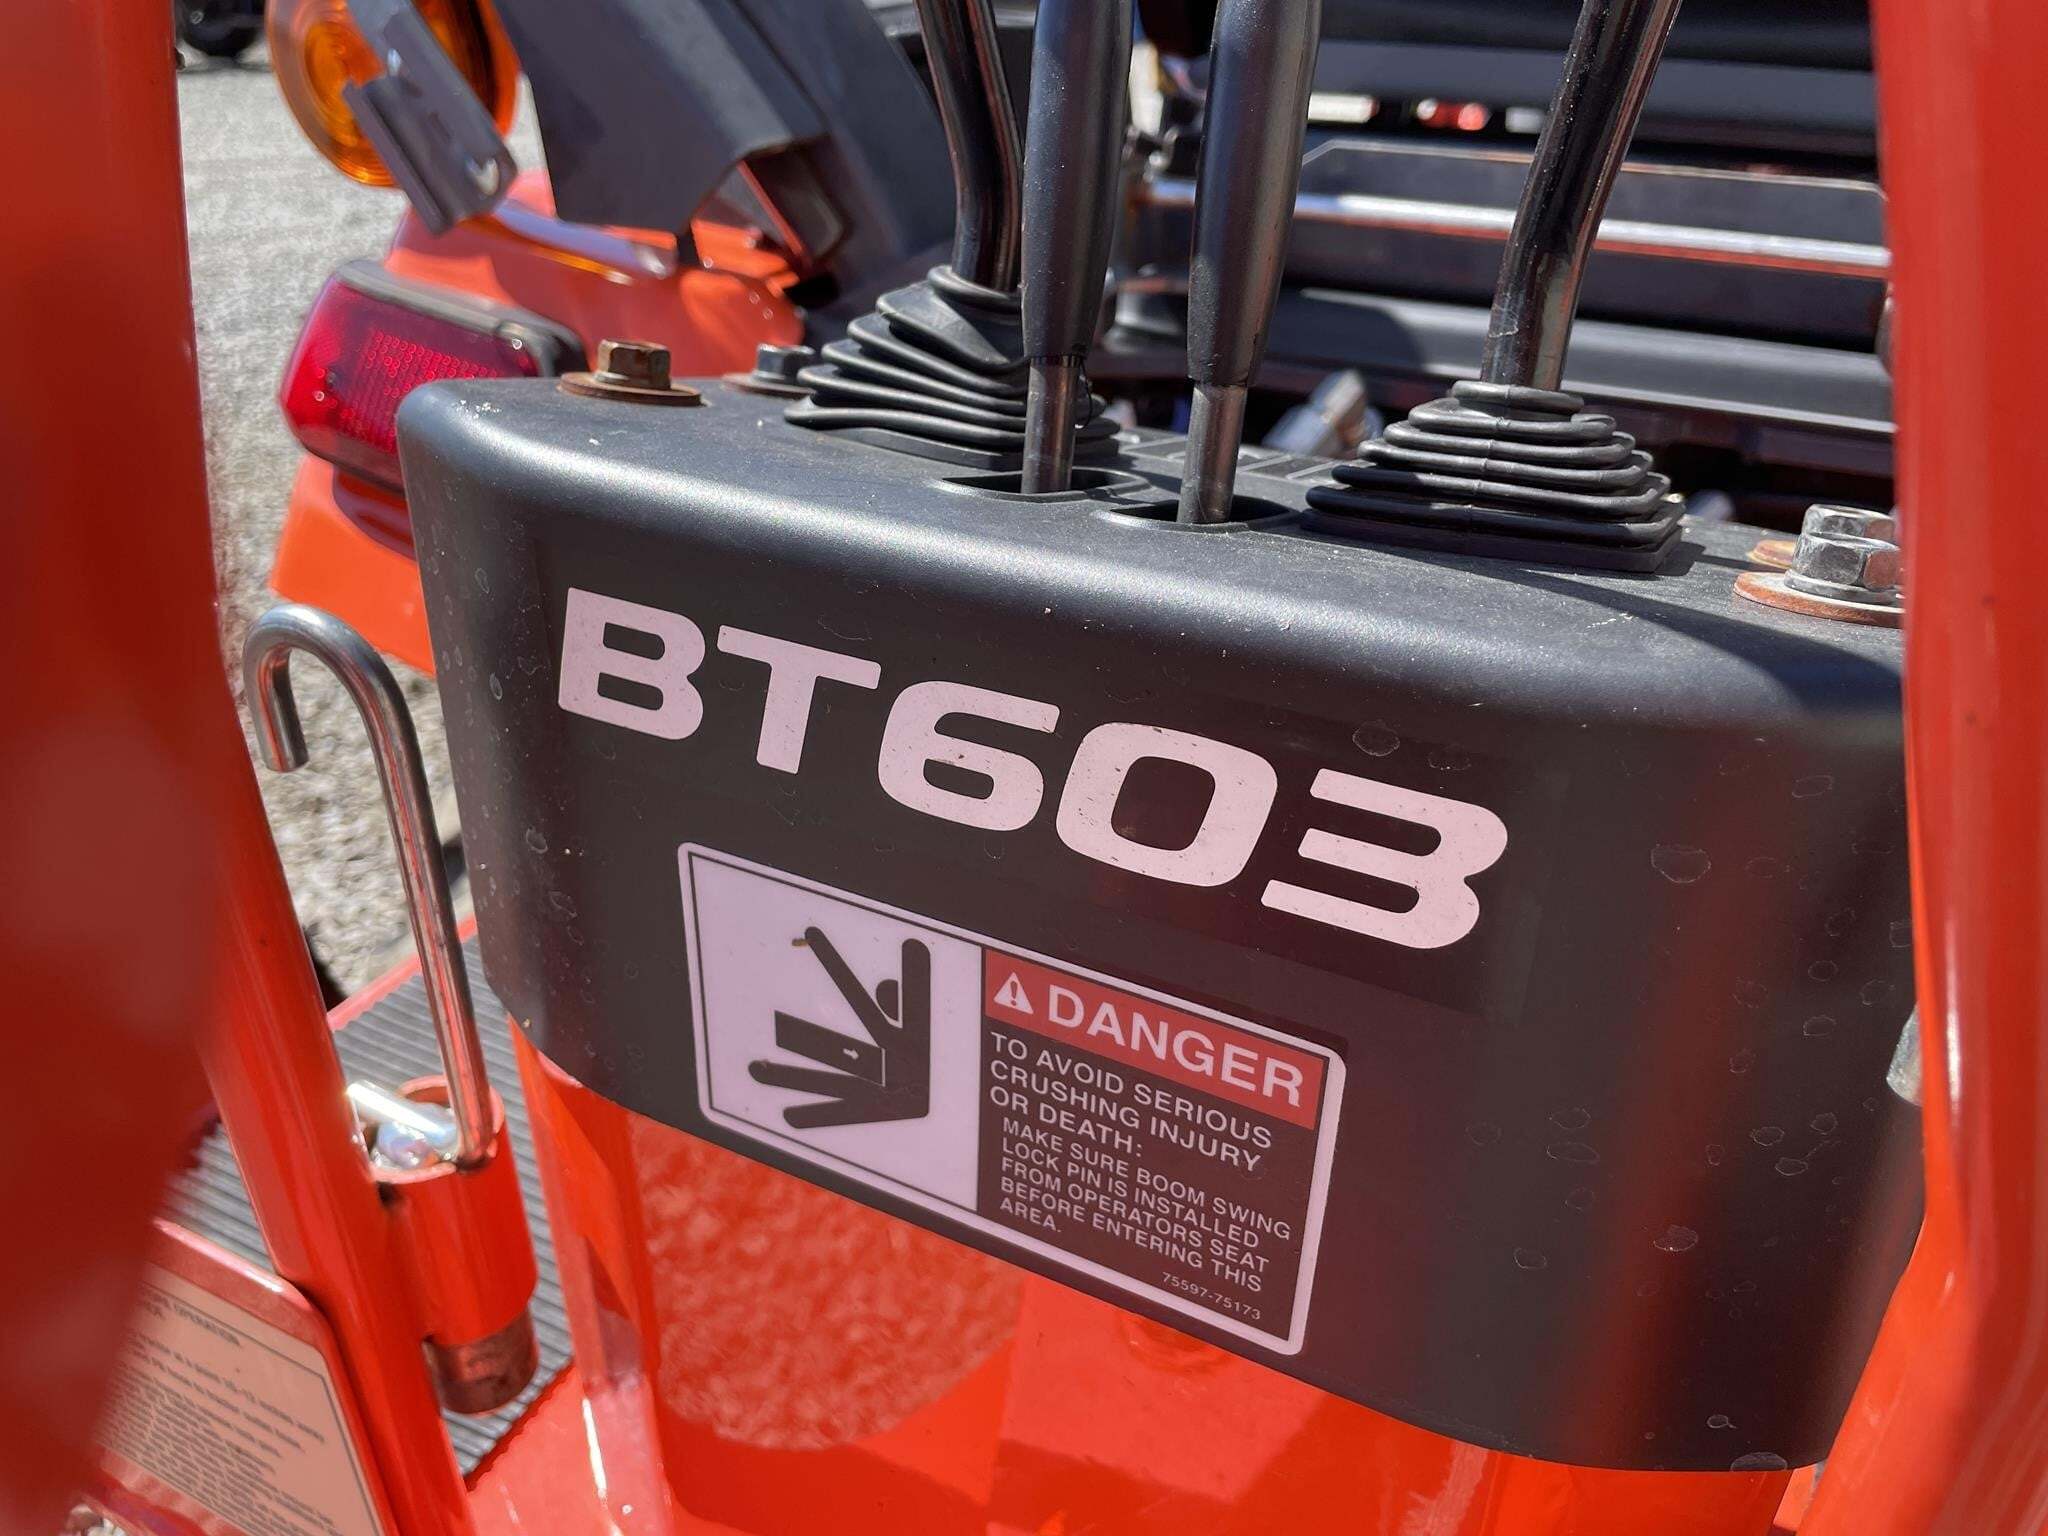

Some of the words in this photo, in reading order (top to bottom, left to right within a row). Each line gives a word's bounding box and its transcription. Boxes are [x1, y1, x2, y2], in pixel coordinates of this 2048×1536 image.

[558, 587, 1509, 951] BT603
[990, 1032, 1028, 1060] TO
[1037, 1049, 1124, 1095] AVOID
[1134, 1083, 1272, 1149] SERIOUS
[1048, 984, 1304, 1107] DANGER
[990, 1060, 1141, 1129] CRUSHING
[1150, 1118, 1262, 1173] INJURY
[990, 1086, 1029, 1116] OR
[1039, 1101, 1143, 1158] DEATH:
[999, 1197, 1062, 1234] AREA.
[1001, 1178, 1085, 1223] BEFORE
[1092, 1216, 1203, 1269] ENTERING
[1211, 1258, 1262, 1292] THIS
[1002, 1158, 1062, 1192] FROM
[1068, 1182, 1202, 1249] OPERATORS
[1210, 1238, 1270, 1274] SEAT
[1003, 1116, 1063, 1151] MAKE
[1070, 1143, 1129, 1178] SURE
[1137, 1167, 1206, 1208] BOOM
[1213, 1196, 1291, 1240] SWING
[1003, 1139, 1060, 1171] LOCK
[1067, 1162, 1101, 1188] PIN
[1108, 1177, 1128, 1198] IS
[1135, 1187, 1259, 1249] INSTALLED
[1162, 1271, 1262, 1321] 75597-75173
